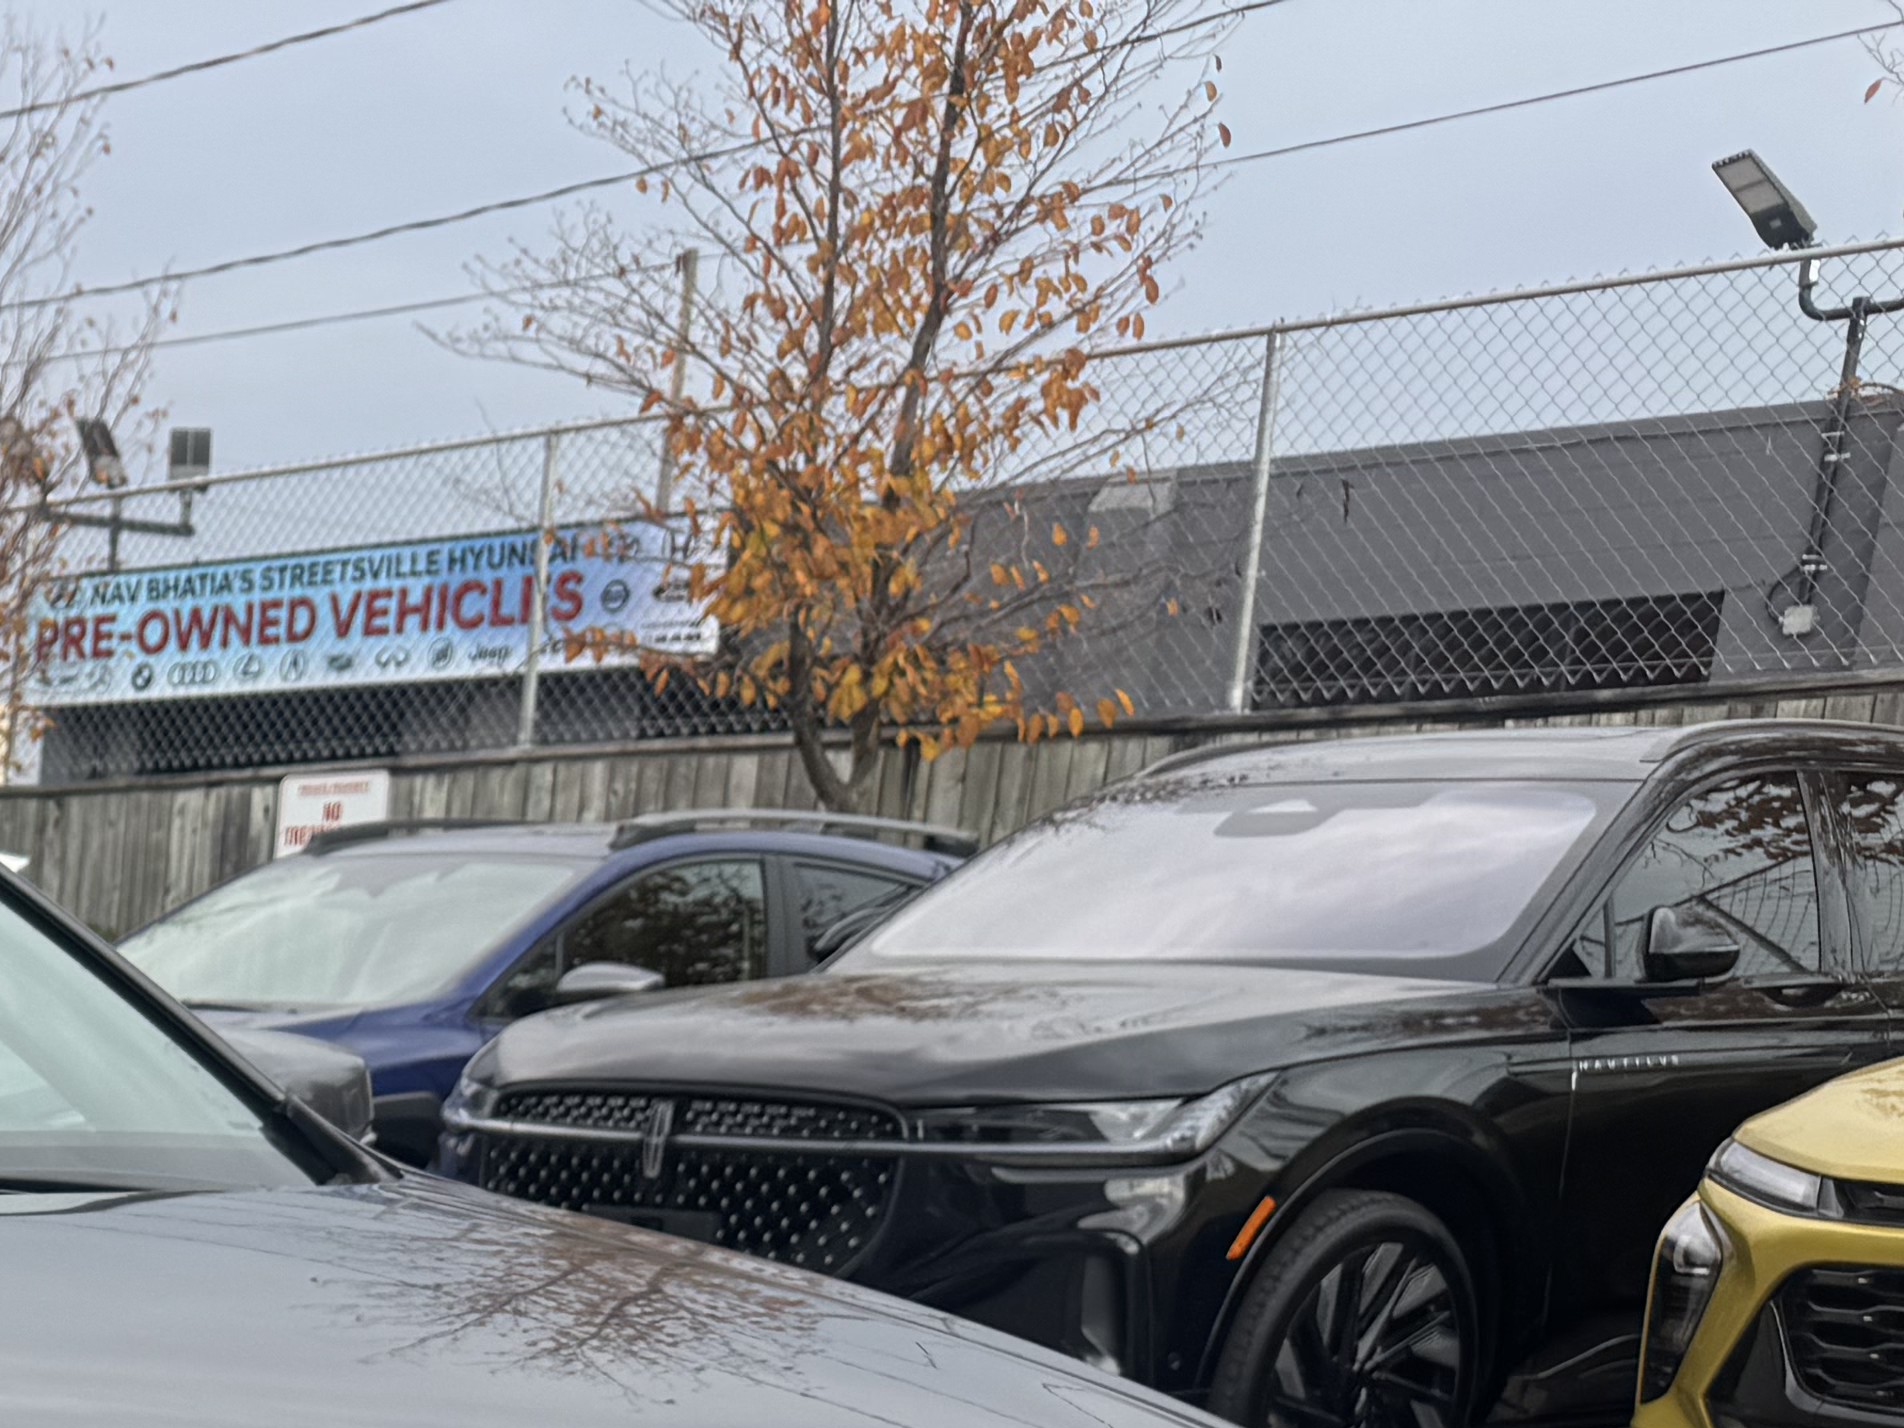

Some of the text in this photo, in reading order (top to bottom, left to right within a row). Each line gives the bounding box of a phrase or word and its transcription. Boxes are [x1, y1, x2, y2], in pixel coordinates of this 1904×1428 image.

[91, 578, 142, 606] NAV
[145, 567, 255, 601] BHATIA'S
[259, 548, 441, 592] STREETSVILLE
[36, 595, 317, 663] PRE-OWNED
